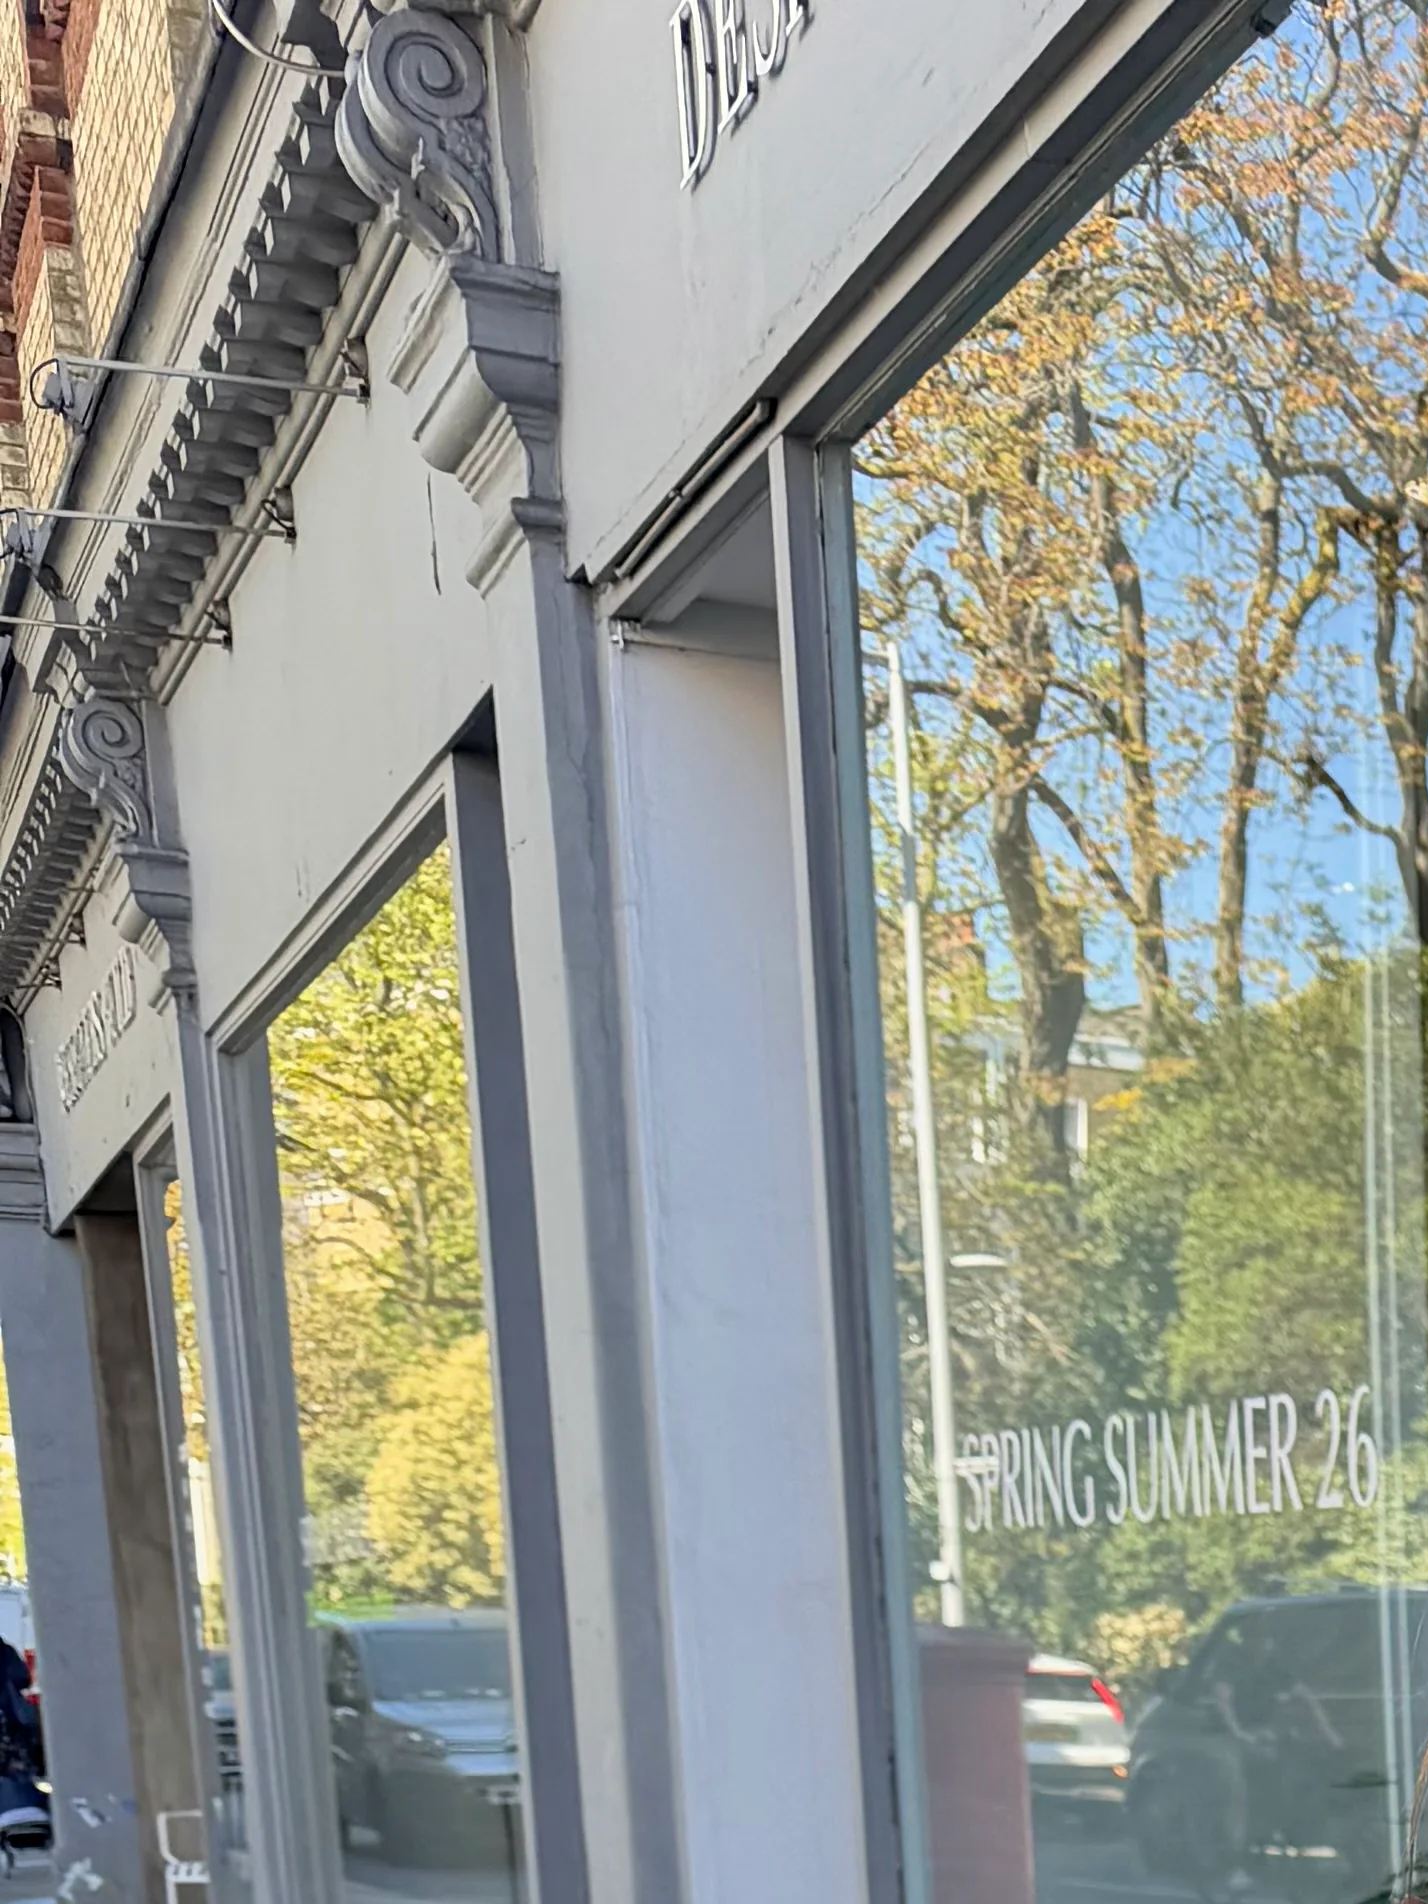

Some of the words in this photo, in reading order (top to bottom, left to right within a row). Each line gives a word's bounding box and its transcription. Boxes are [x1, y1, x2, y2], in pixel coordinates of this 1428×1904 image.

[964, 1419, 1096, 1533] SPRING
[1103, 1392, 1304, 1526] SUMMER
[1315, 1384, 1380, 1509] 26
